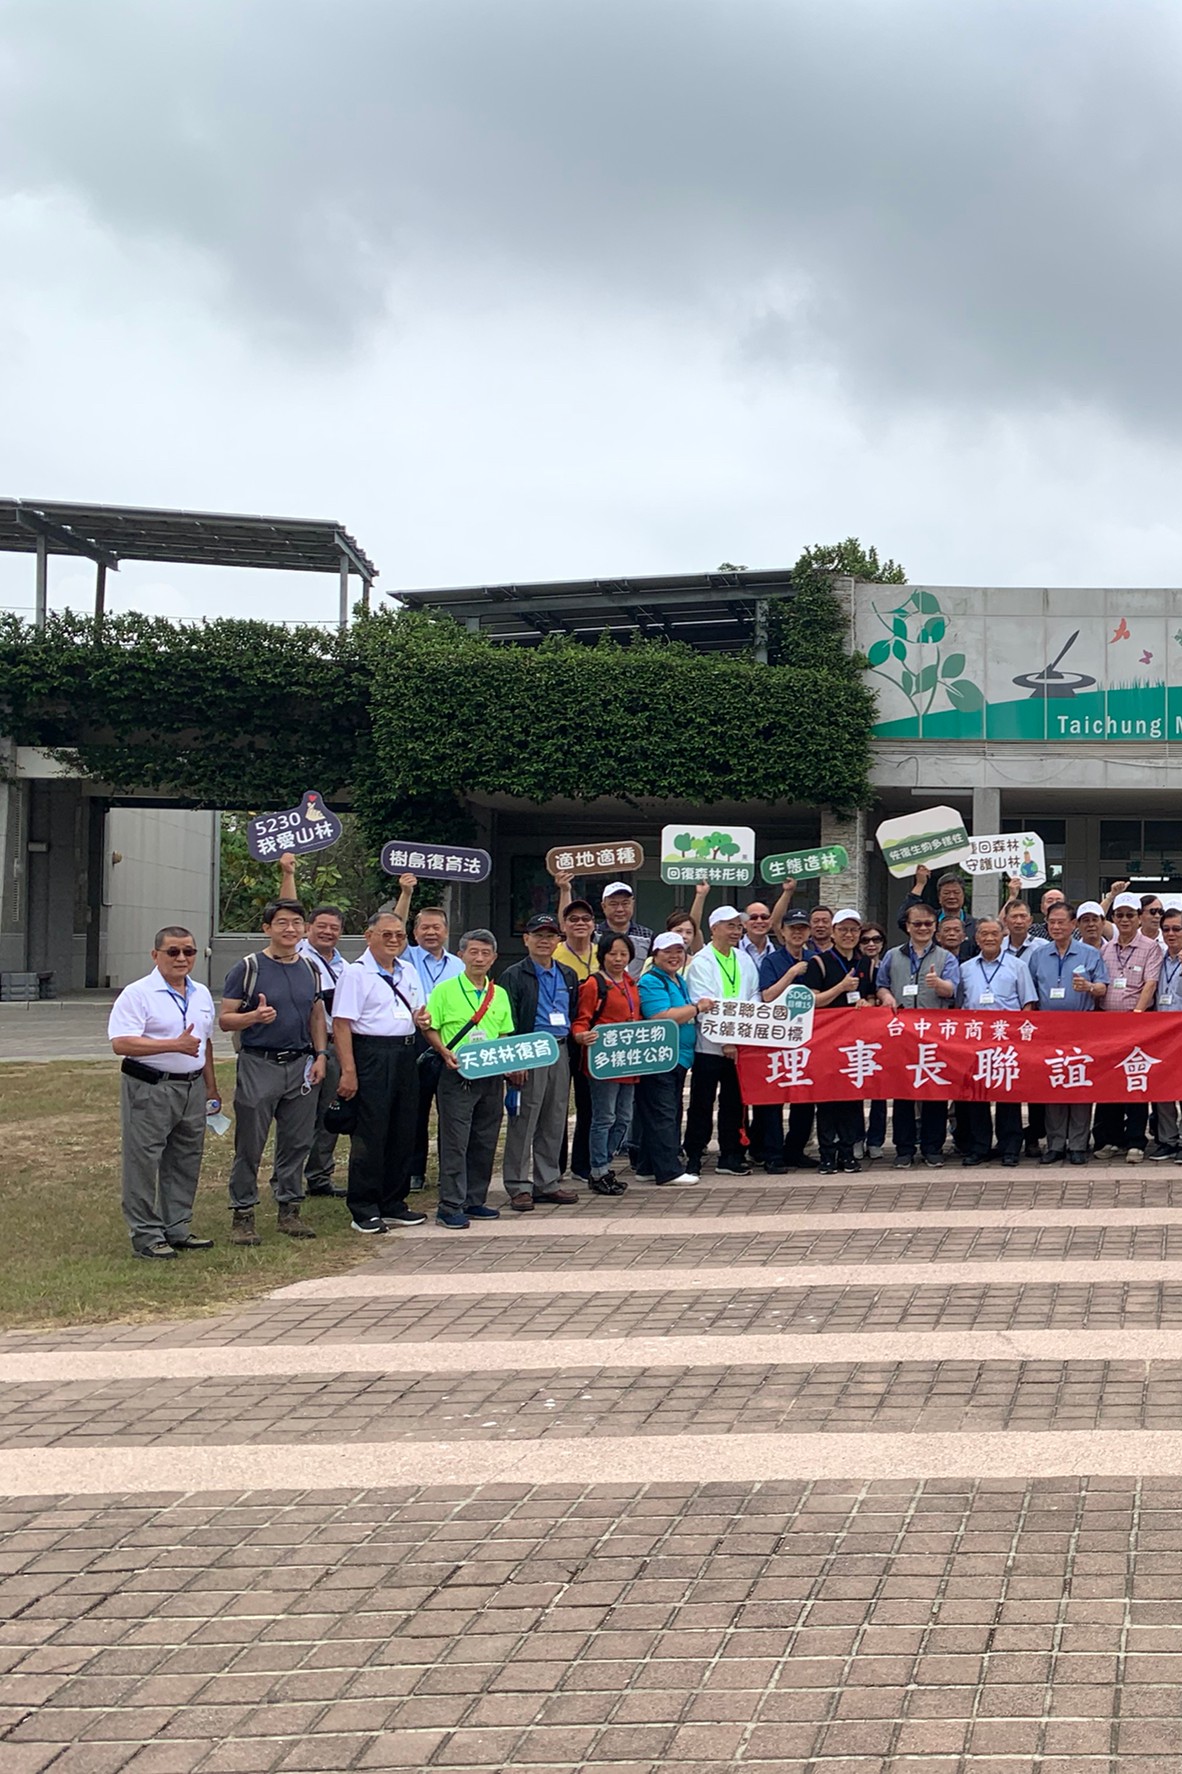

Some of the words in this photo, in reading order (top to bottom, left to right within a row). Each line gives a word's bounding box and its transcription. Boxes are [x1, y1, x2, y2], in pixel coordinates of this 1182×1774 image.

[1057, 715, 1162, 738] Taichung
[255, 812, 301, 836] 5230
[257, 821, 334, 855] 我愛山林
[555, 847, 636, 870] 適地適種
[769, 852, 838, 877] 生態造林
[966, 855, 1021, 872] 守護山林
[787, 990, 811, 1000] SDGs
[602, 1026, 666, 1048] 遵守生物
[703, 1019, 803, 1042] 永續發展目標
[886, 1018, 1039, 1041] 台中市商業會
[460, 1038, 552, 1070] 天然林復育
[594, 1047, 673, 1069] 多樣性公約
[765, 1040, 1163, 1093] 理事長聯誼會
